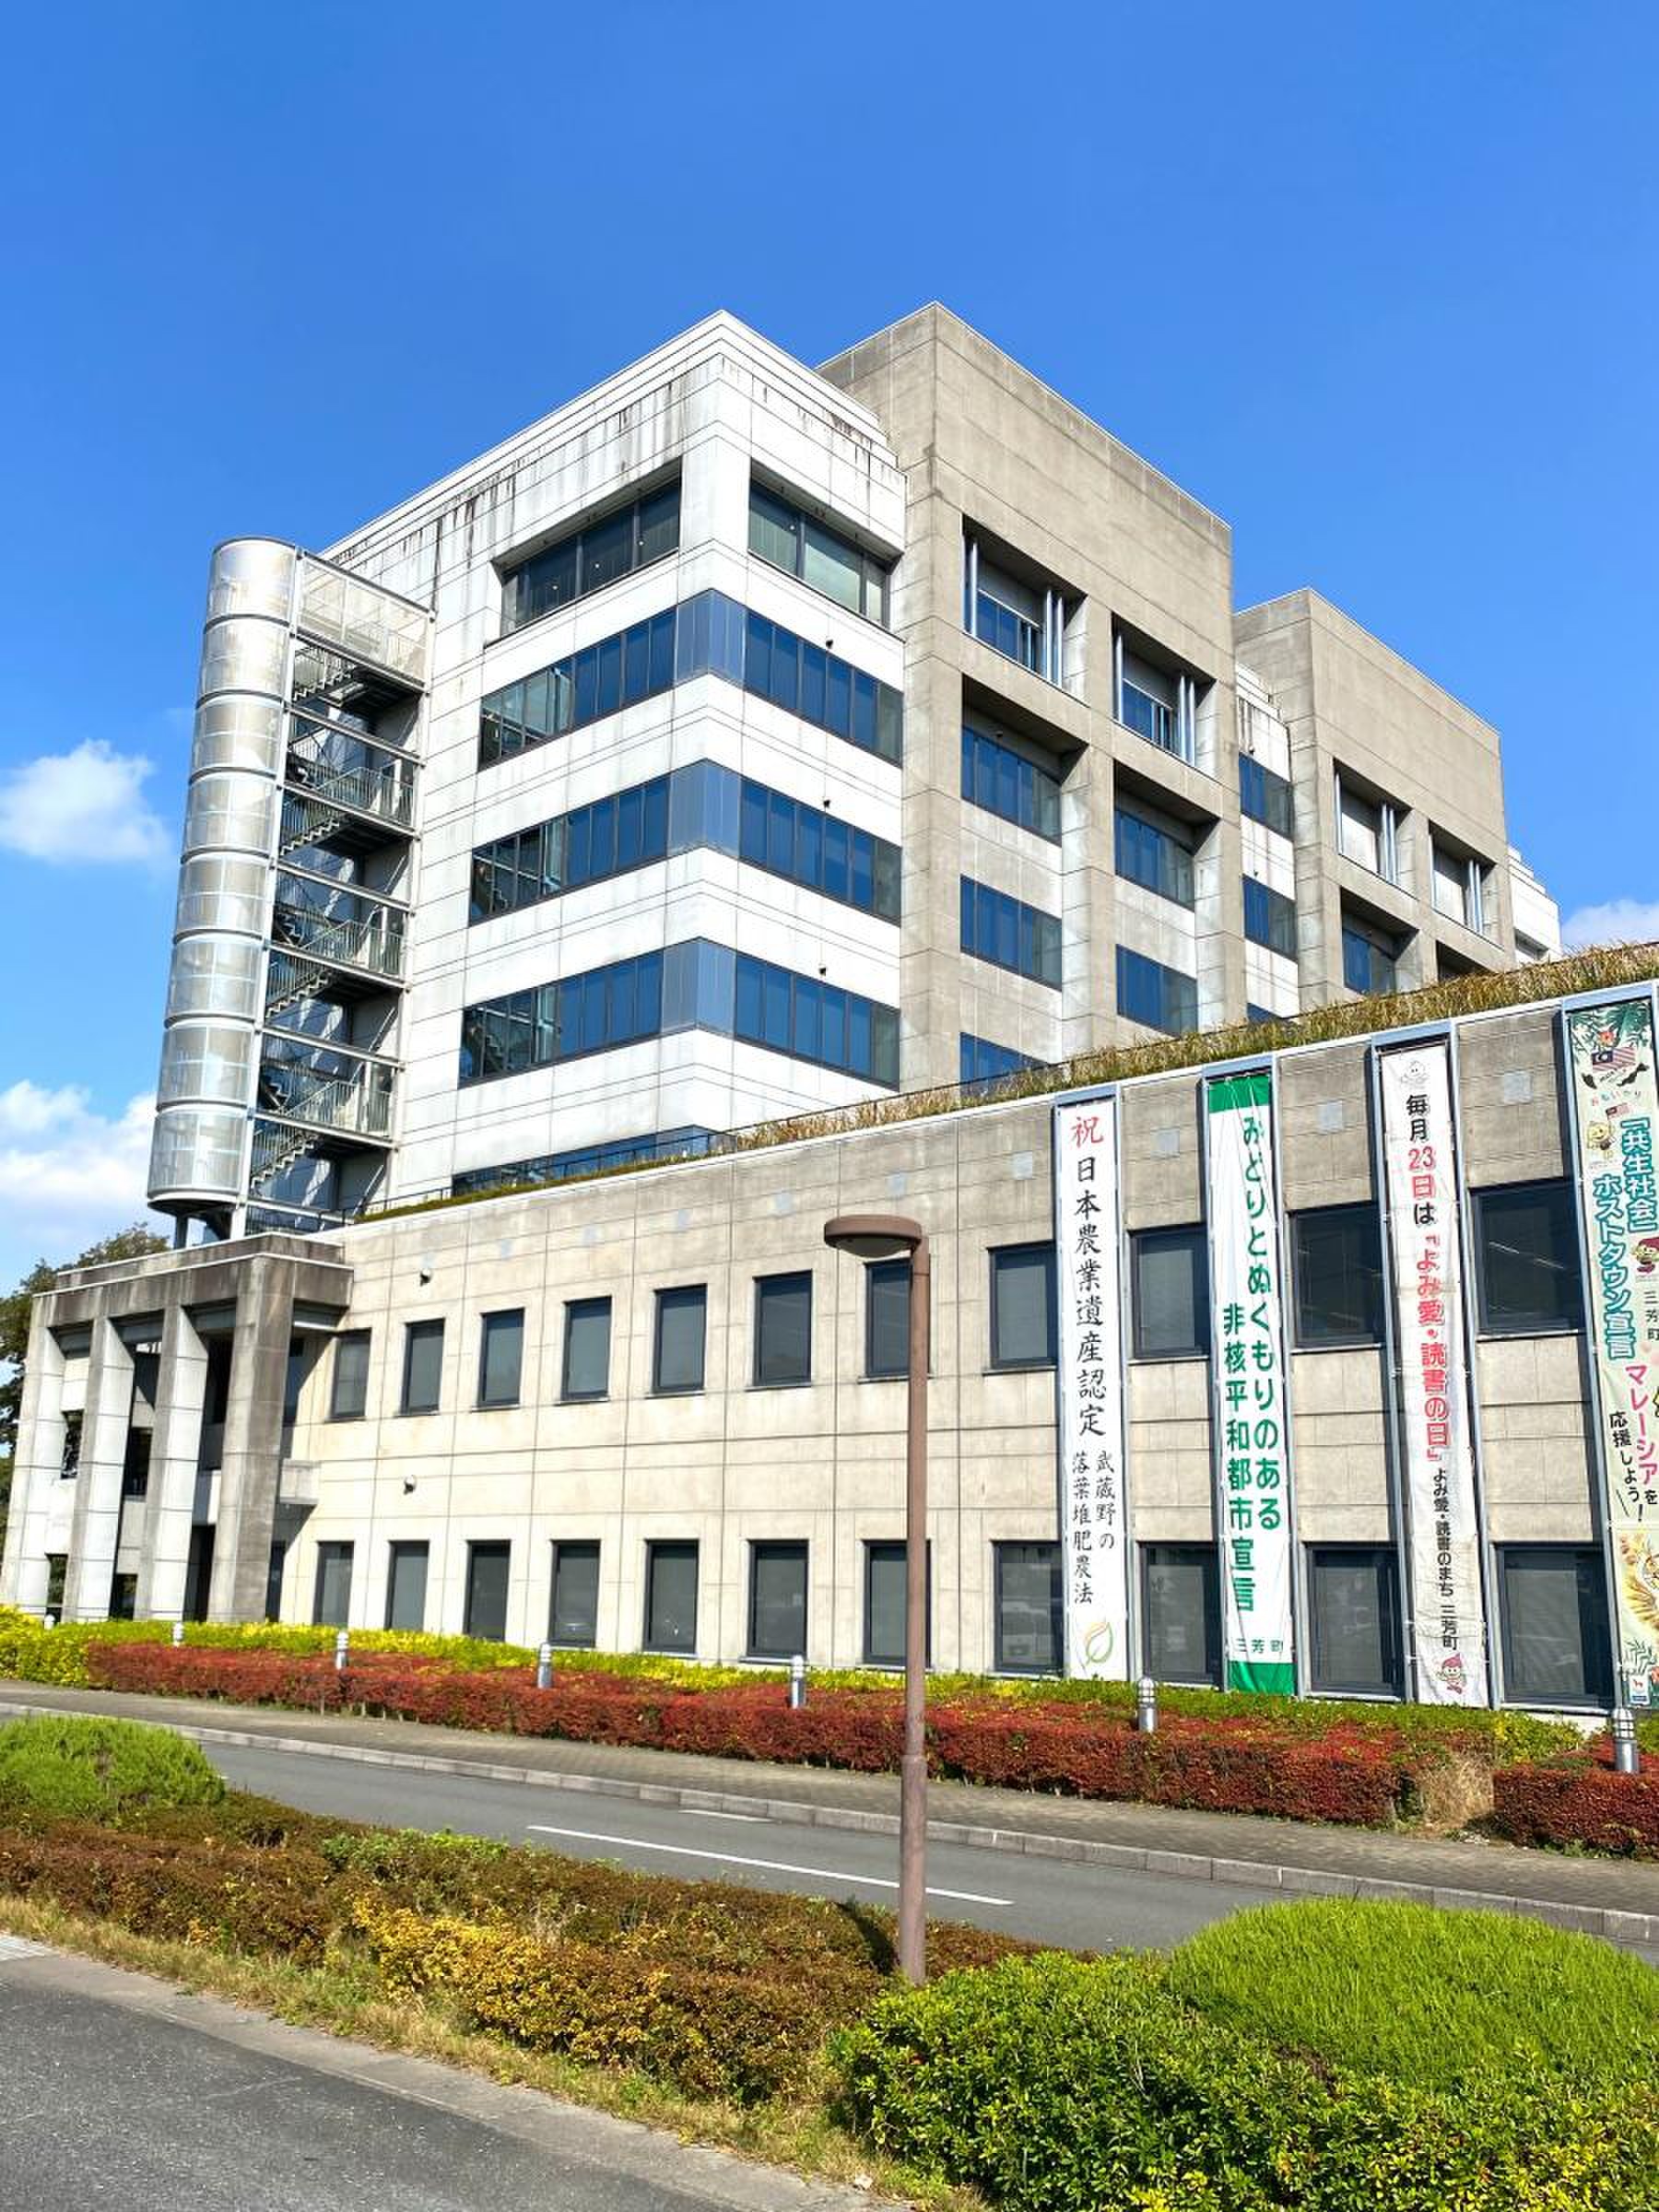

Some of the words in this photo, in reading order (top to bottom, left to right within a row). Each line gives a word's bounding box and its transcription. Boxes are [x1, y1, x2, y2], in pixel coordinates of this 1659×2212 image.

[1593, 1172, 1637, 1360] ホストタウン宣言
[1072, 1453, 1094, 1605] 落葉堆肥農法
[1094, 1450, 1116, 1549] 武蔵野の
[1223, 1302, 1256, 1612] 非核平和都市宣言
[1441, 1605, 1457, 1651] 三芳町
